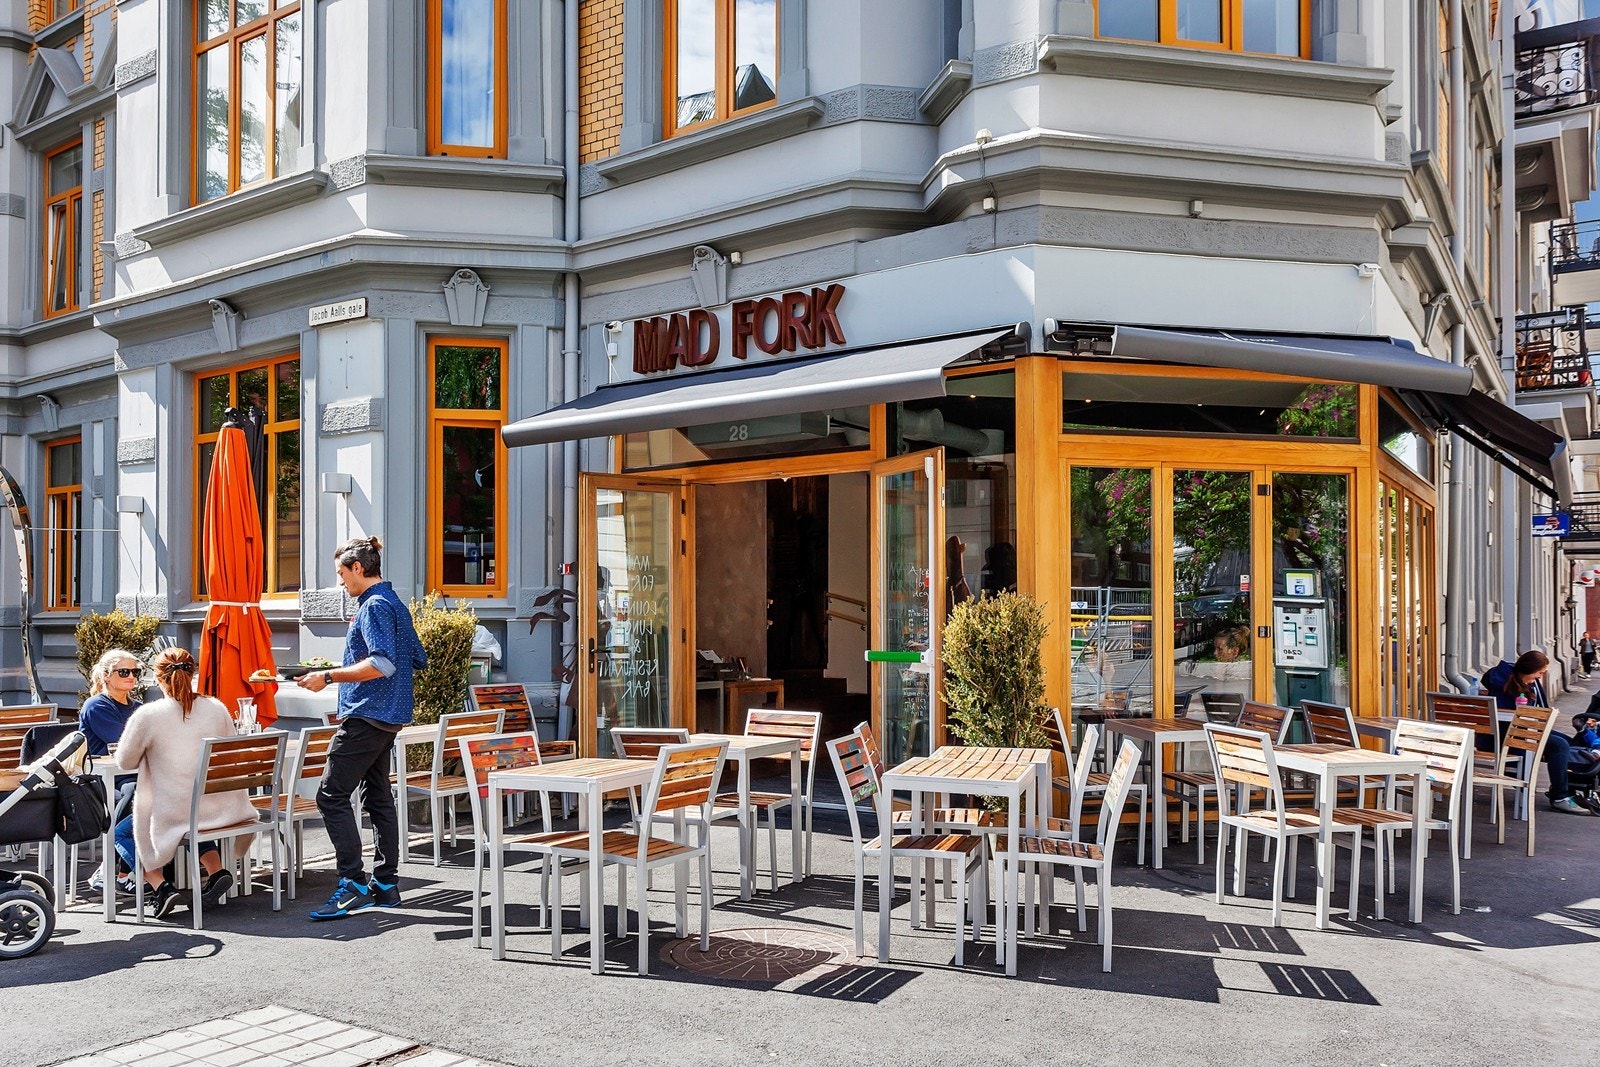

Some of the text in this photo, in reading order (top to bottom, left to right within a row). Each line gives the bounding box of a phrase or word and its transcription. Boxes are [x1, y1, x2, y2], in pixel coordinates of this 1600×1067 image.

[311, 302, 363, 321] Jacob Aalls gate
[633, 283, 847, 374] MAD FORK
[729, 424, 748, 441] 28
[124, 882, 136, 892] N
